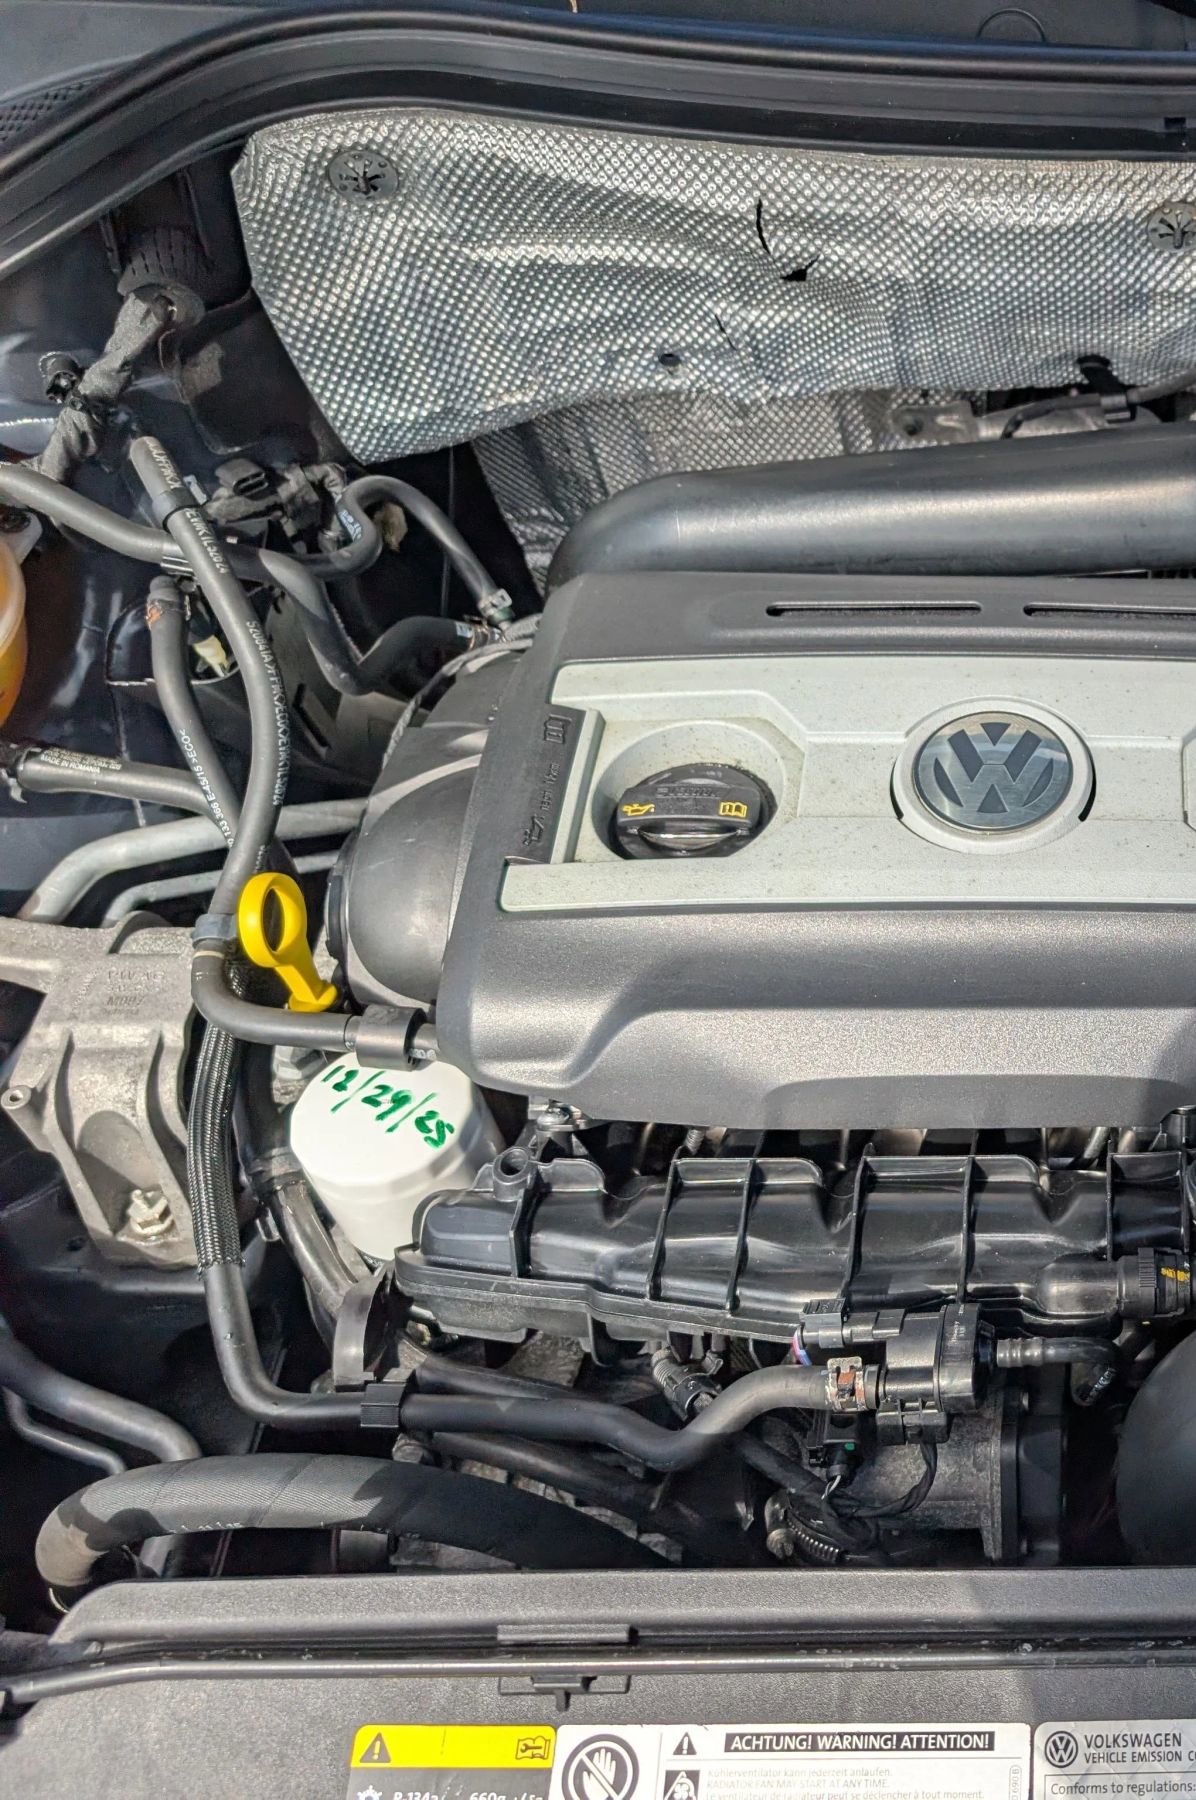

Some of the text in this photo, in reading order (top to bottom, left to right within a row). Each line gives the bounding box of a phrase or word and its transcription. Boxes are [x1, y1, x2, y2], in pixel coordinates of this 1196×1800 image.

[320, 1064, 455, 1149] 12/29/25
[731, 1733, 989, 1751] ACHTUNG! WARNING! ATTENTION!
[1084, 1732, 1182, 1749] VOLKSWAGEN
[1084, 1751, 1127, 1764] VEHICLE
[1131, 1750, 1183, 1763] EMISSION
[842, 1779, 862, 1788] ANY
[1050, 1782, 1108, 1796] Conforms
[1112, 1782, 1123, 1793] to
[1126, 1780, 1196, 1797] regulations:
